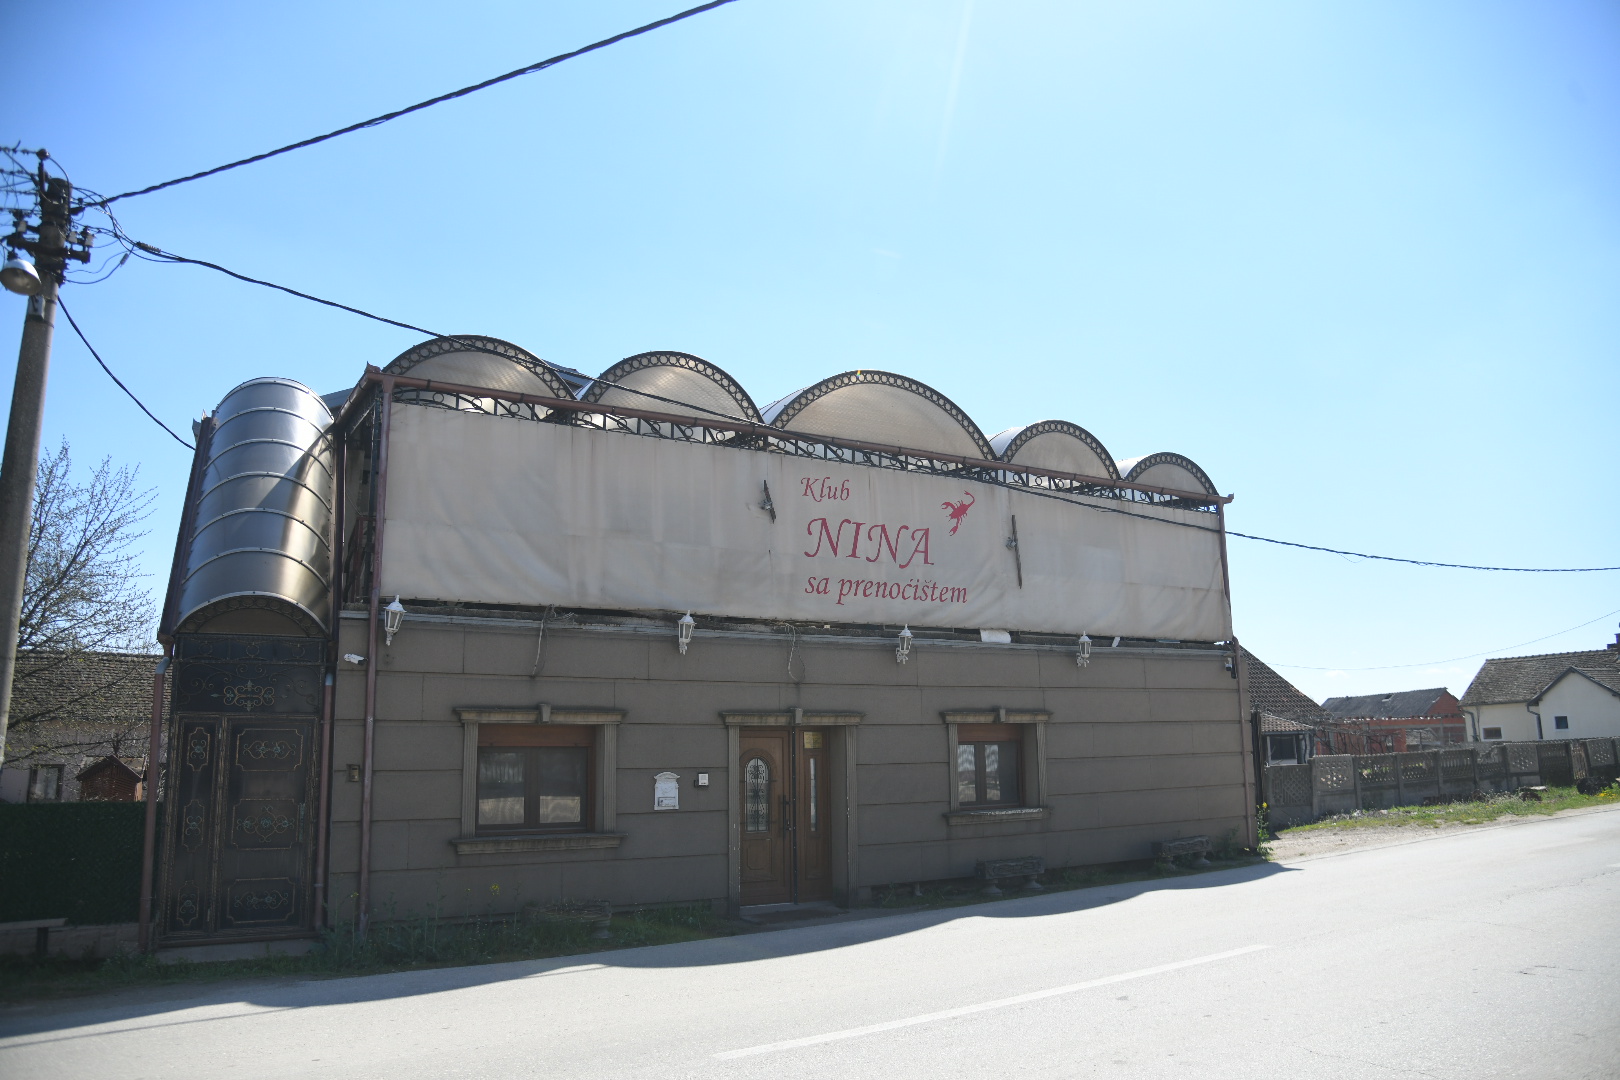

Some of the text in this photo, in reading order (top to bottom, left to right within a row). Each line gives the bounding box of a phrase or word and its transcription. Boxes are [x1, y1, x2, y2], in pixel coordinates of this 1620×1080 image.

[800, 476, 850, 502] Klub
[804, 517, 935, 569] NINA
[804, 576, 968, 605] sa prenoćištem
